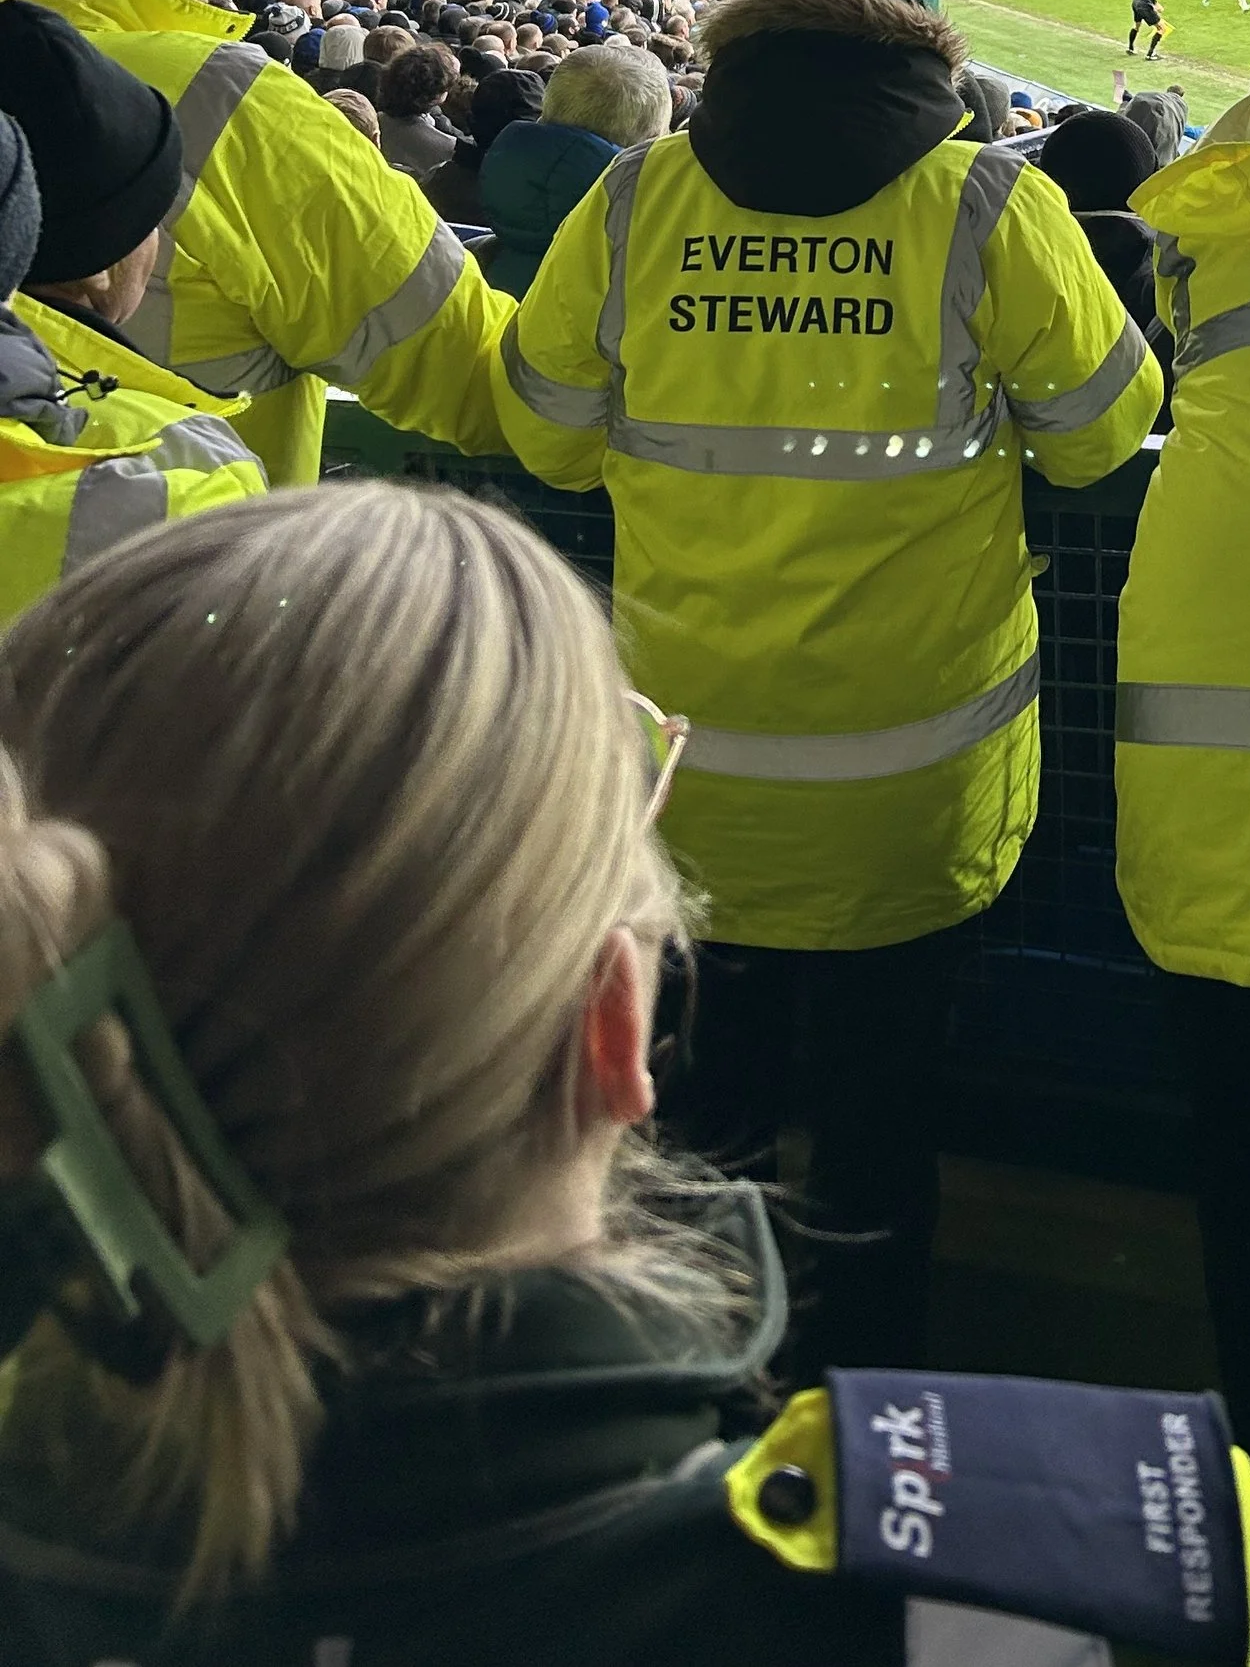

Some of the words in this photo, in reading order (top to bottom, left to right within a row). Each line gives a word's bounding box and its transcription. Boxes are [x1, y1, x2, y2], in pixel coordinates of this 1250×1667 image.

[681, 235, 893, 275] EVERTON
[669, 294, 894, 335] STEWARD
[1135, 1460, 1175, 1554] FIRST
[1160, 1412, 1214, 1623] RESPONDER
